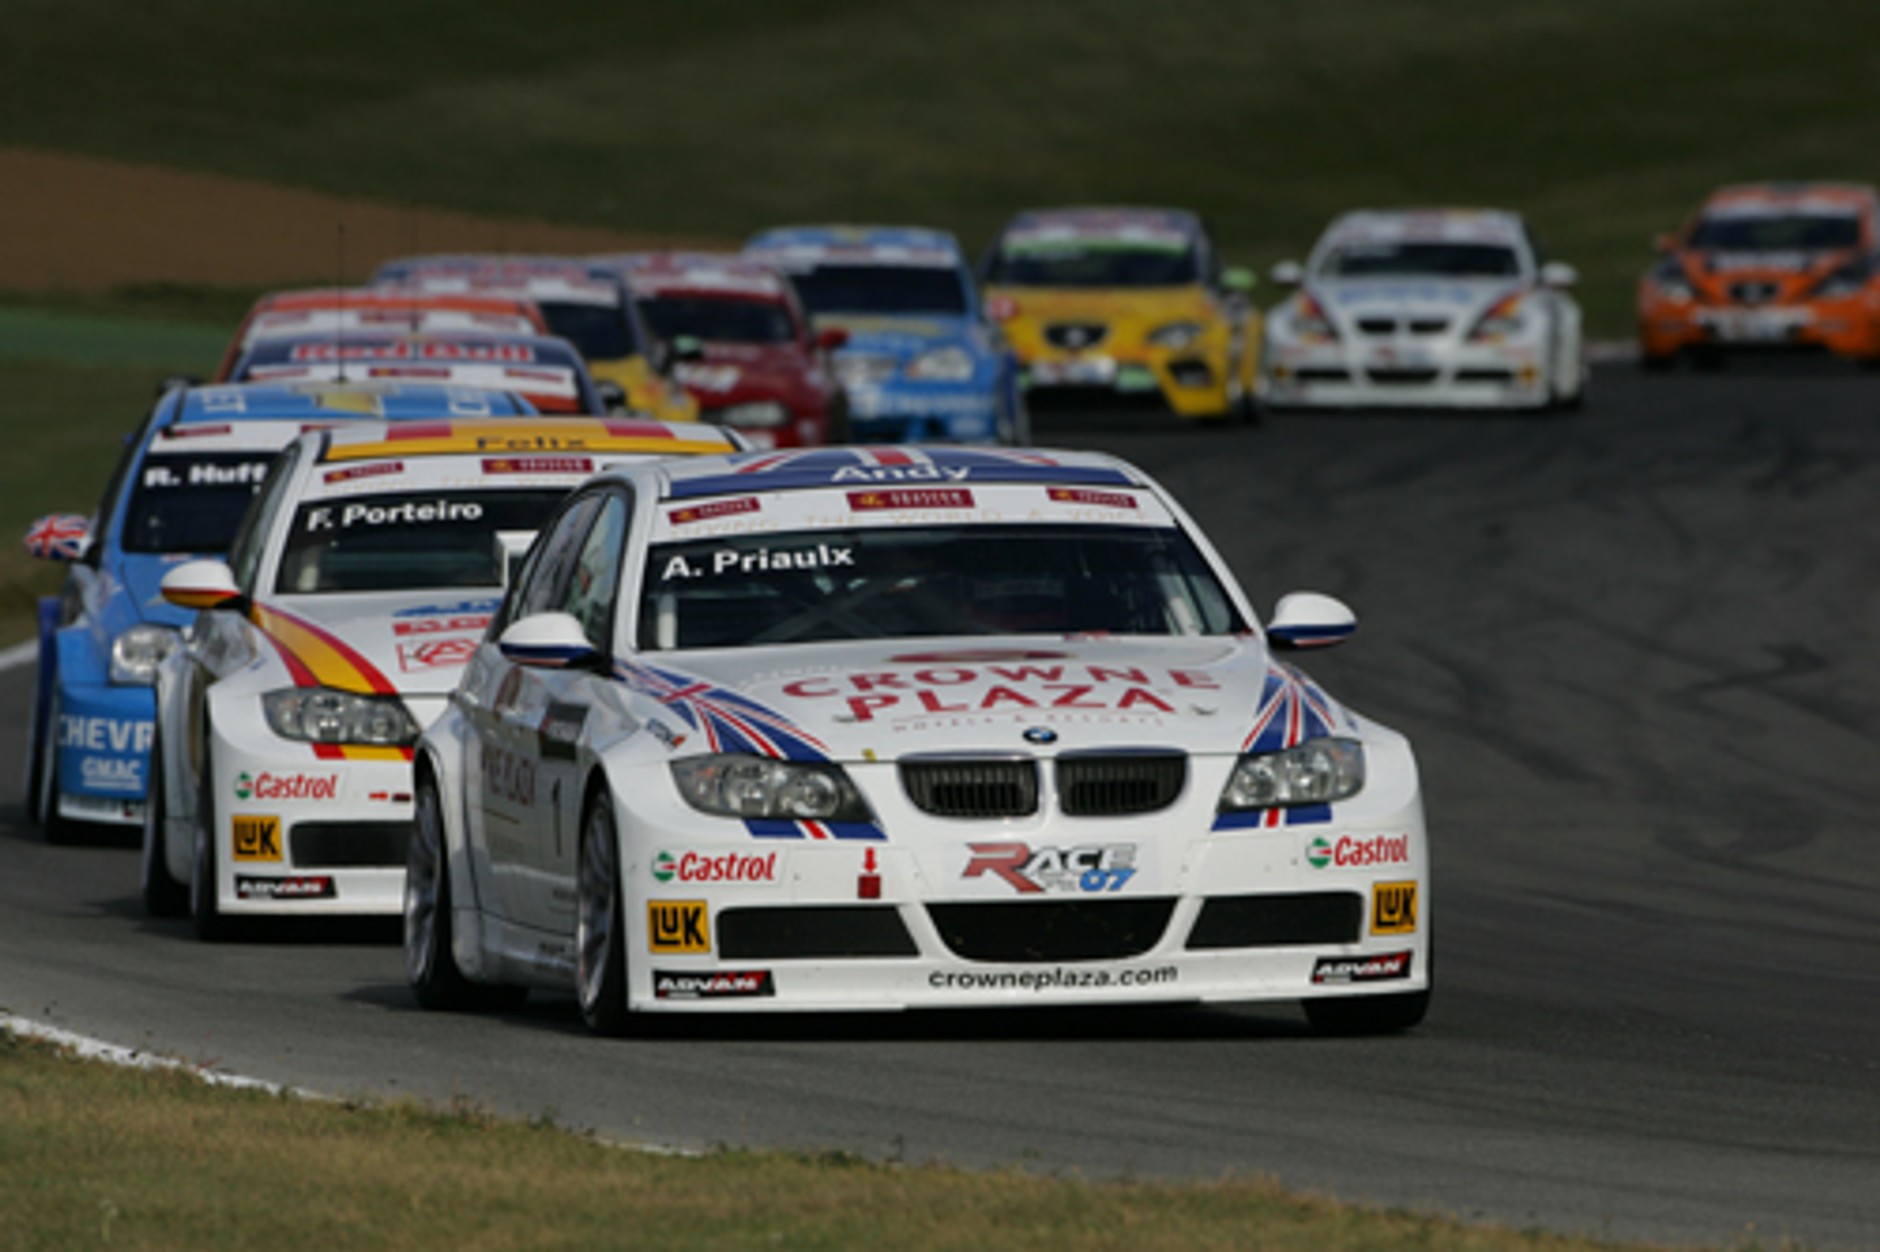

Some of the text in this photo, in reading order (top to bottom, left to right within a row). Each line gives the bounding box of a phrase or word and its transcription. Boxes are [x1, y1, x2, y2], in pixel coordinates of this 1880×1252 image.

[477, 434, 584, 449] Felix
[188, 462, 268, 484] Huff
[831, 466, 970, 482] Andy
[307, 500, 483, 531] F. Porteiro
[662, 544, 855, 579] A. Priaulx
[782, 664, 1221, 697] CROWNE
[846, 685, 1176, 722] PLAZA
[254, 771, 338, 800] Castrol
[1334, 833, 1409, 867] Castrol
[678, 850, 777, 882] Castrol
[961, 841, 1137, 893] RACE
[1079, 868, 1137, 892] 07
[928, 966, 1180, 992] crowneplaza.com
[1316, 957, 1402, 977] ADVAN
[658, 976, 759, 992] ADVAN
